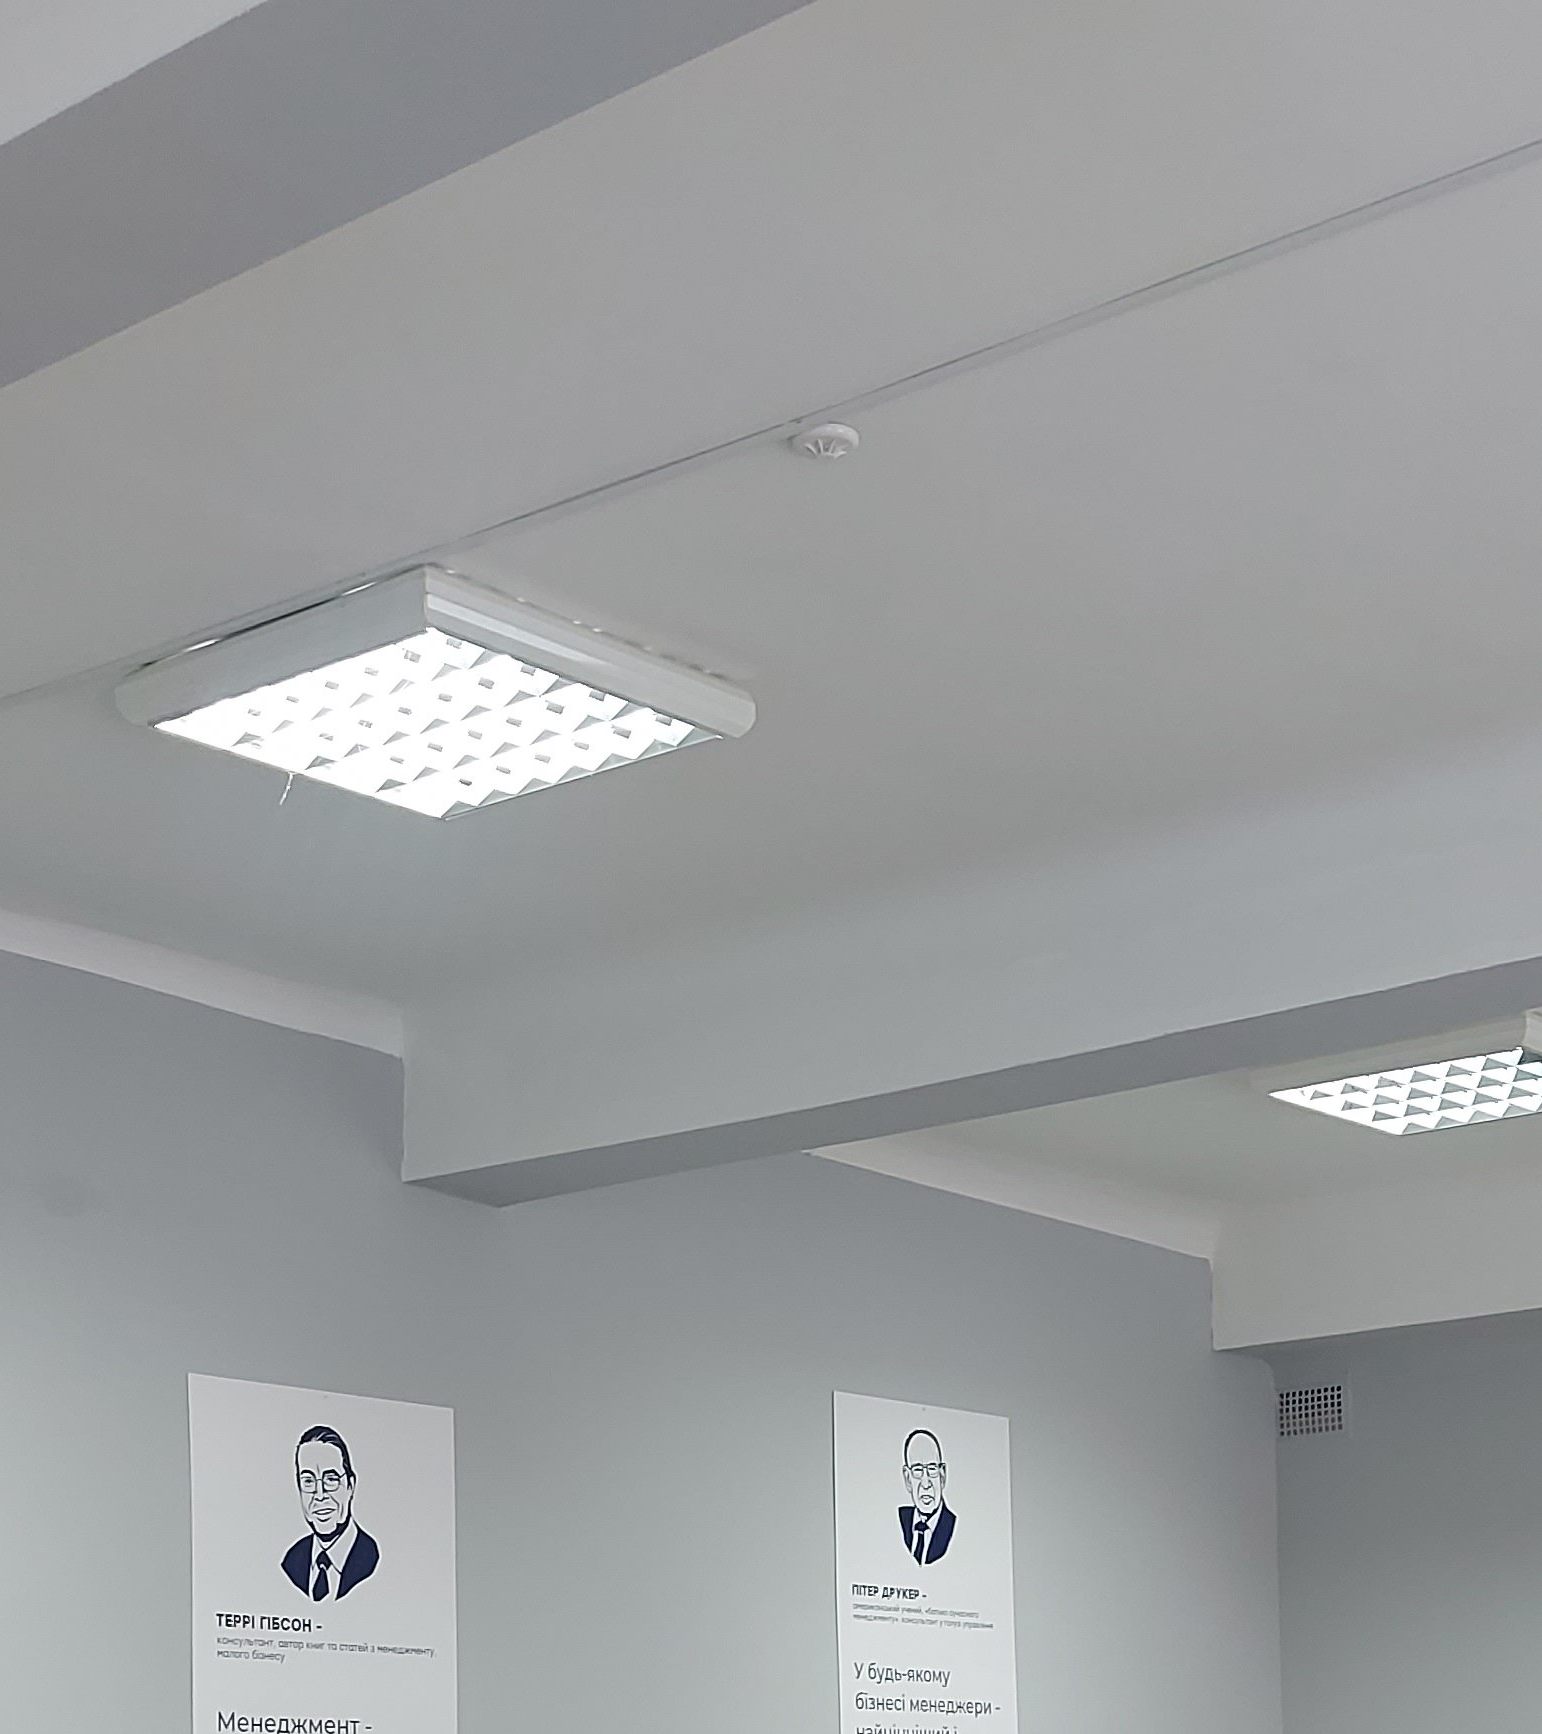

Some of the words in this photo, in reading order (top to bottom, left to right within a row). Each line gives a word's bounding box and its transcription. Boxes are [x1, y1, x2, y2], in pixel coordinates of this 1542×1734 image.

[852, 1584, 879, 1597] ПІТЕР
[881, 1586, 920, 1600] ДРУКЕР
[216, 1613, 255, 1629] ТЕРРІ
[260, 1616, 312, 1632] ГІБСОН
[854, 1662, 864, 1680] У
[868, 1662, 951, 1687] будь-якому
[855, 1692, 906, 1711] бізнесі
[909, 1699, 992, 1718] менеджери
